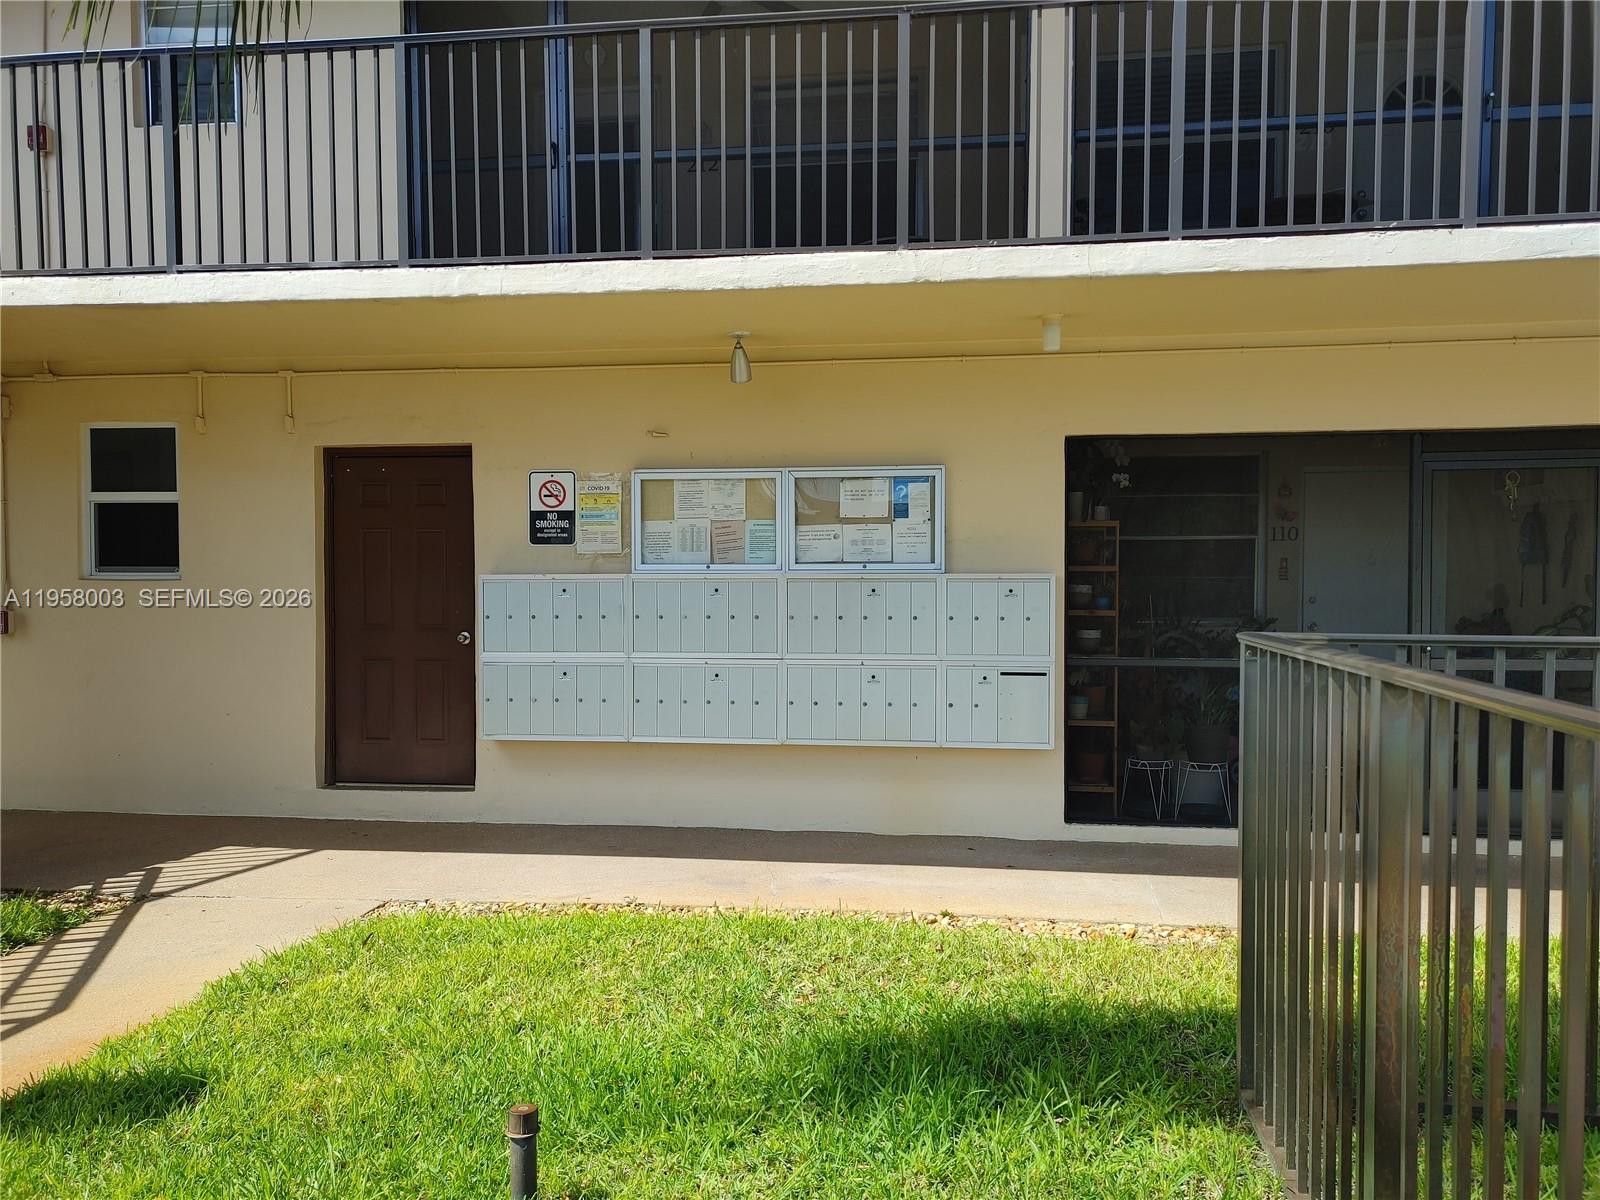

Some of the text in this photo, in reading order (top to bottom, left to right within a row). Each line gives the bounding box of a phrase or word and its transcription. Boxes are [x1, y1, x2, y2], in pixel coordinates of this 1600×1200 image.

[546, 512, 558, 520] NO
[535, 520, 569, 528] SMOKING
[1270, 526, 1299, 541] 110
